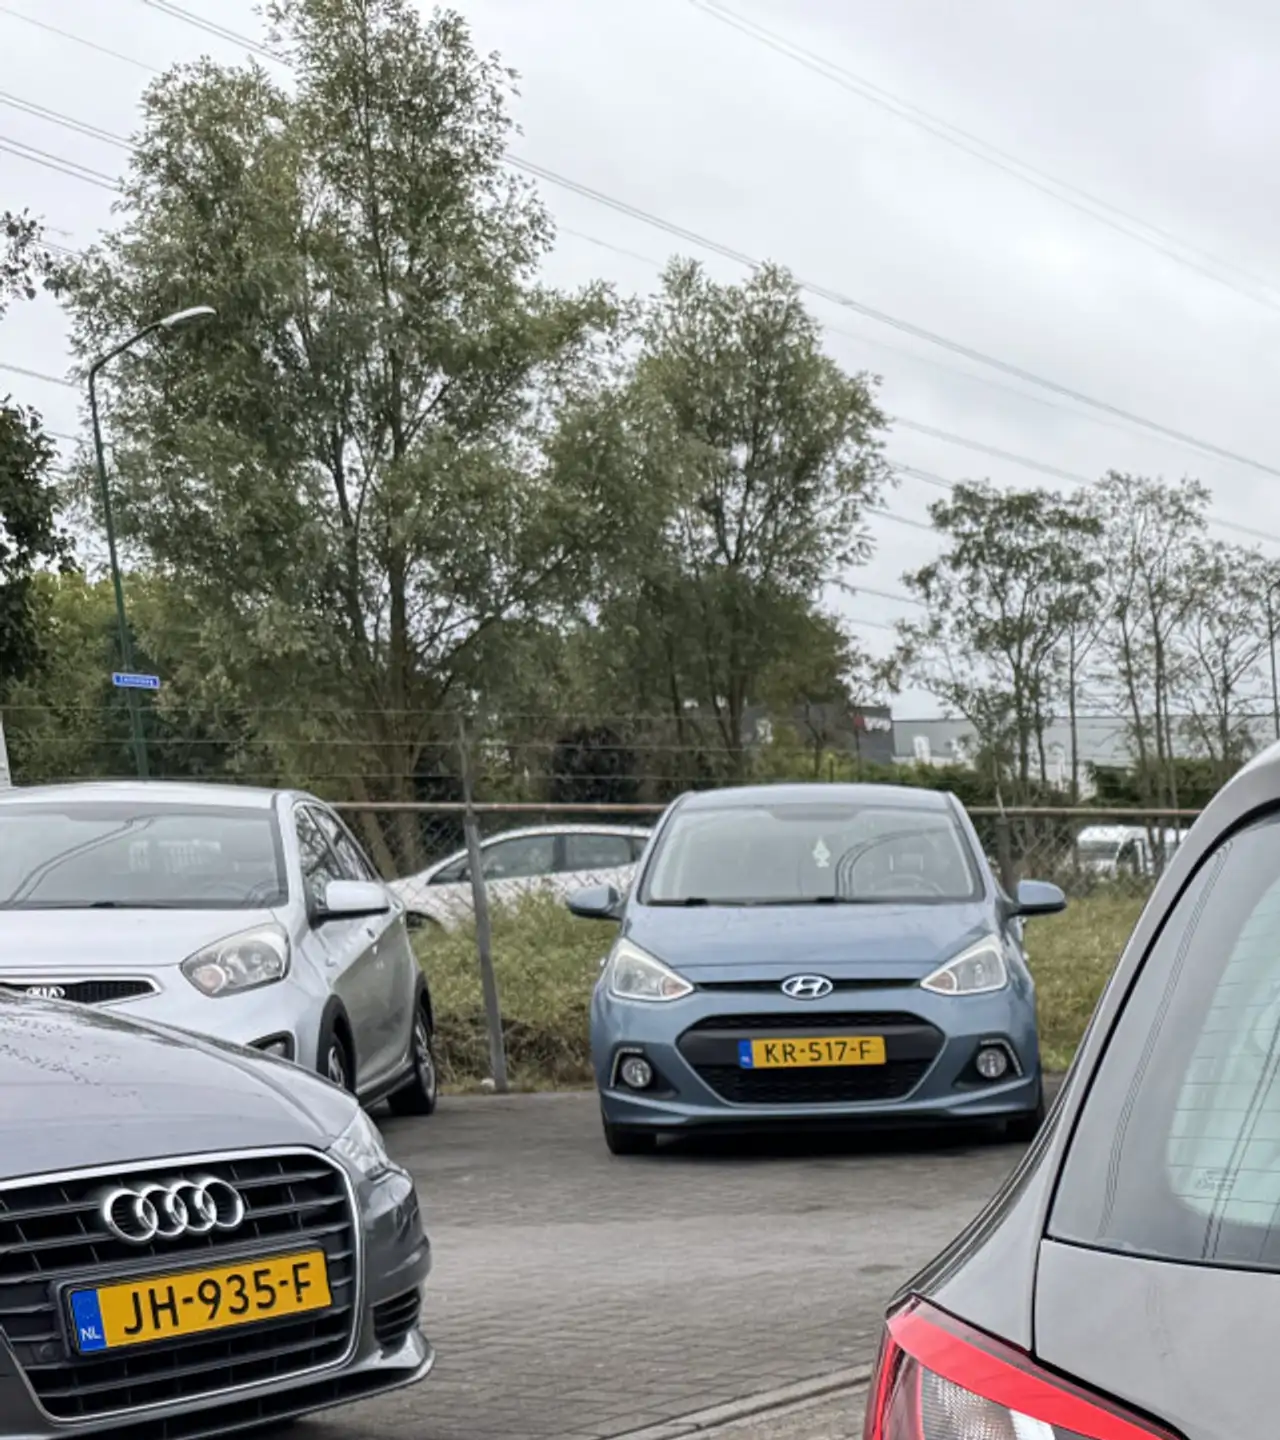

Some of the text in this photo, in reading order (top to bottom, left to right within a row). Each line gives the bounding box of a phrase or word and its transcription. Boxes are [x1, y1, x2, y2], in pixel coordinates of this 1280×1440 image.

[764, 1039, 872, 1064] KR-517-F
[123, 1261, 312, 1336] JH-935-F
[81, 1326, 102, 1341] NL
